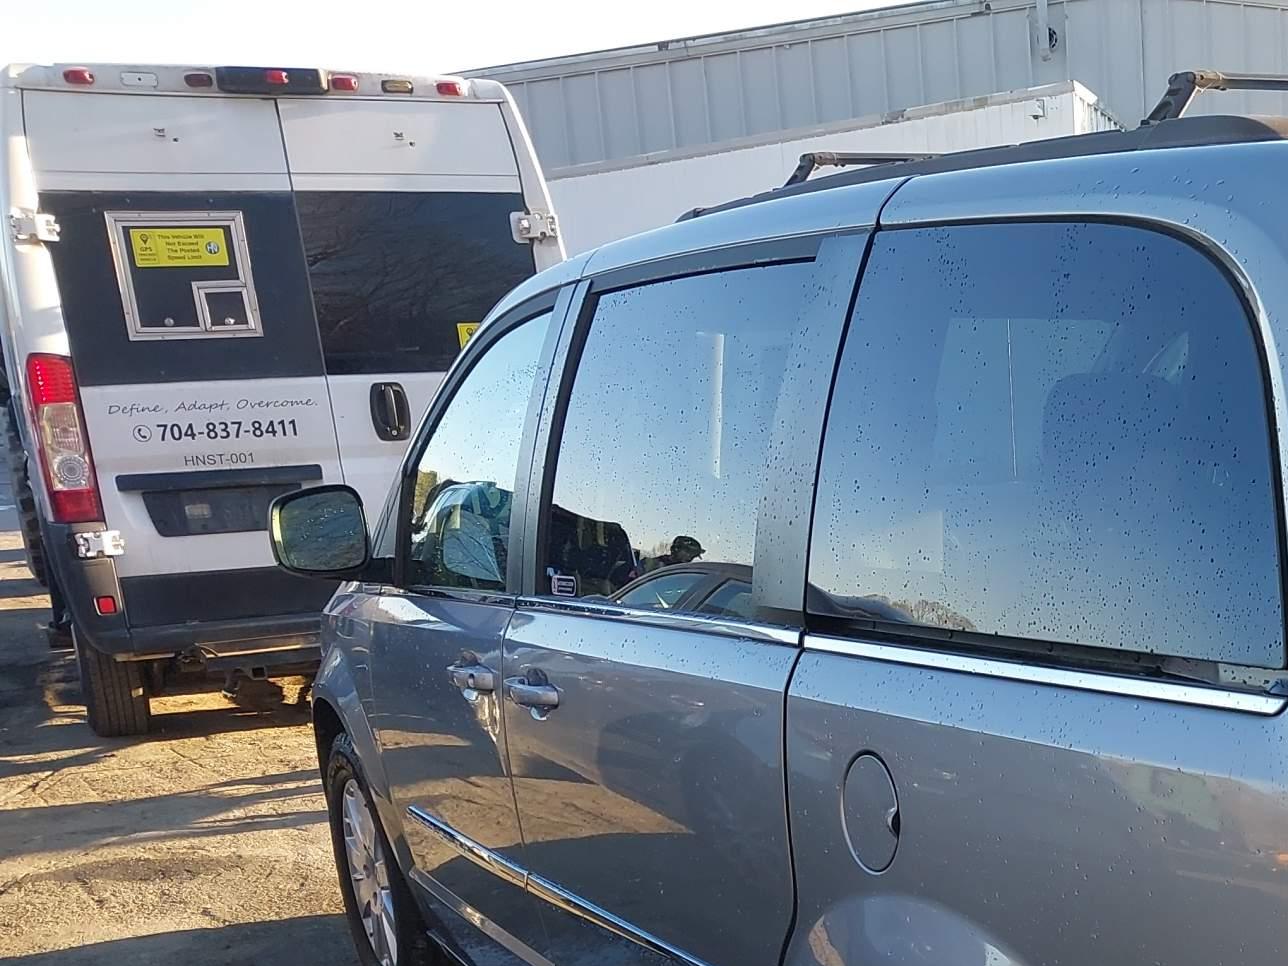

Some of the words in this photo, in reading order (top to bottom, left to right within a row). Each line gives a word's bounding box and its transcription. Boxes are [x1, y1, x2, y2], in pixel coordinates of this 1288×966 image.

[236, 398, 318, 410] Overcome.
[156, 418, 299, 442] 704-837-8411
[184, 452, 255, 467] HNST-001
